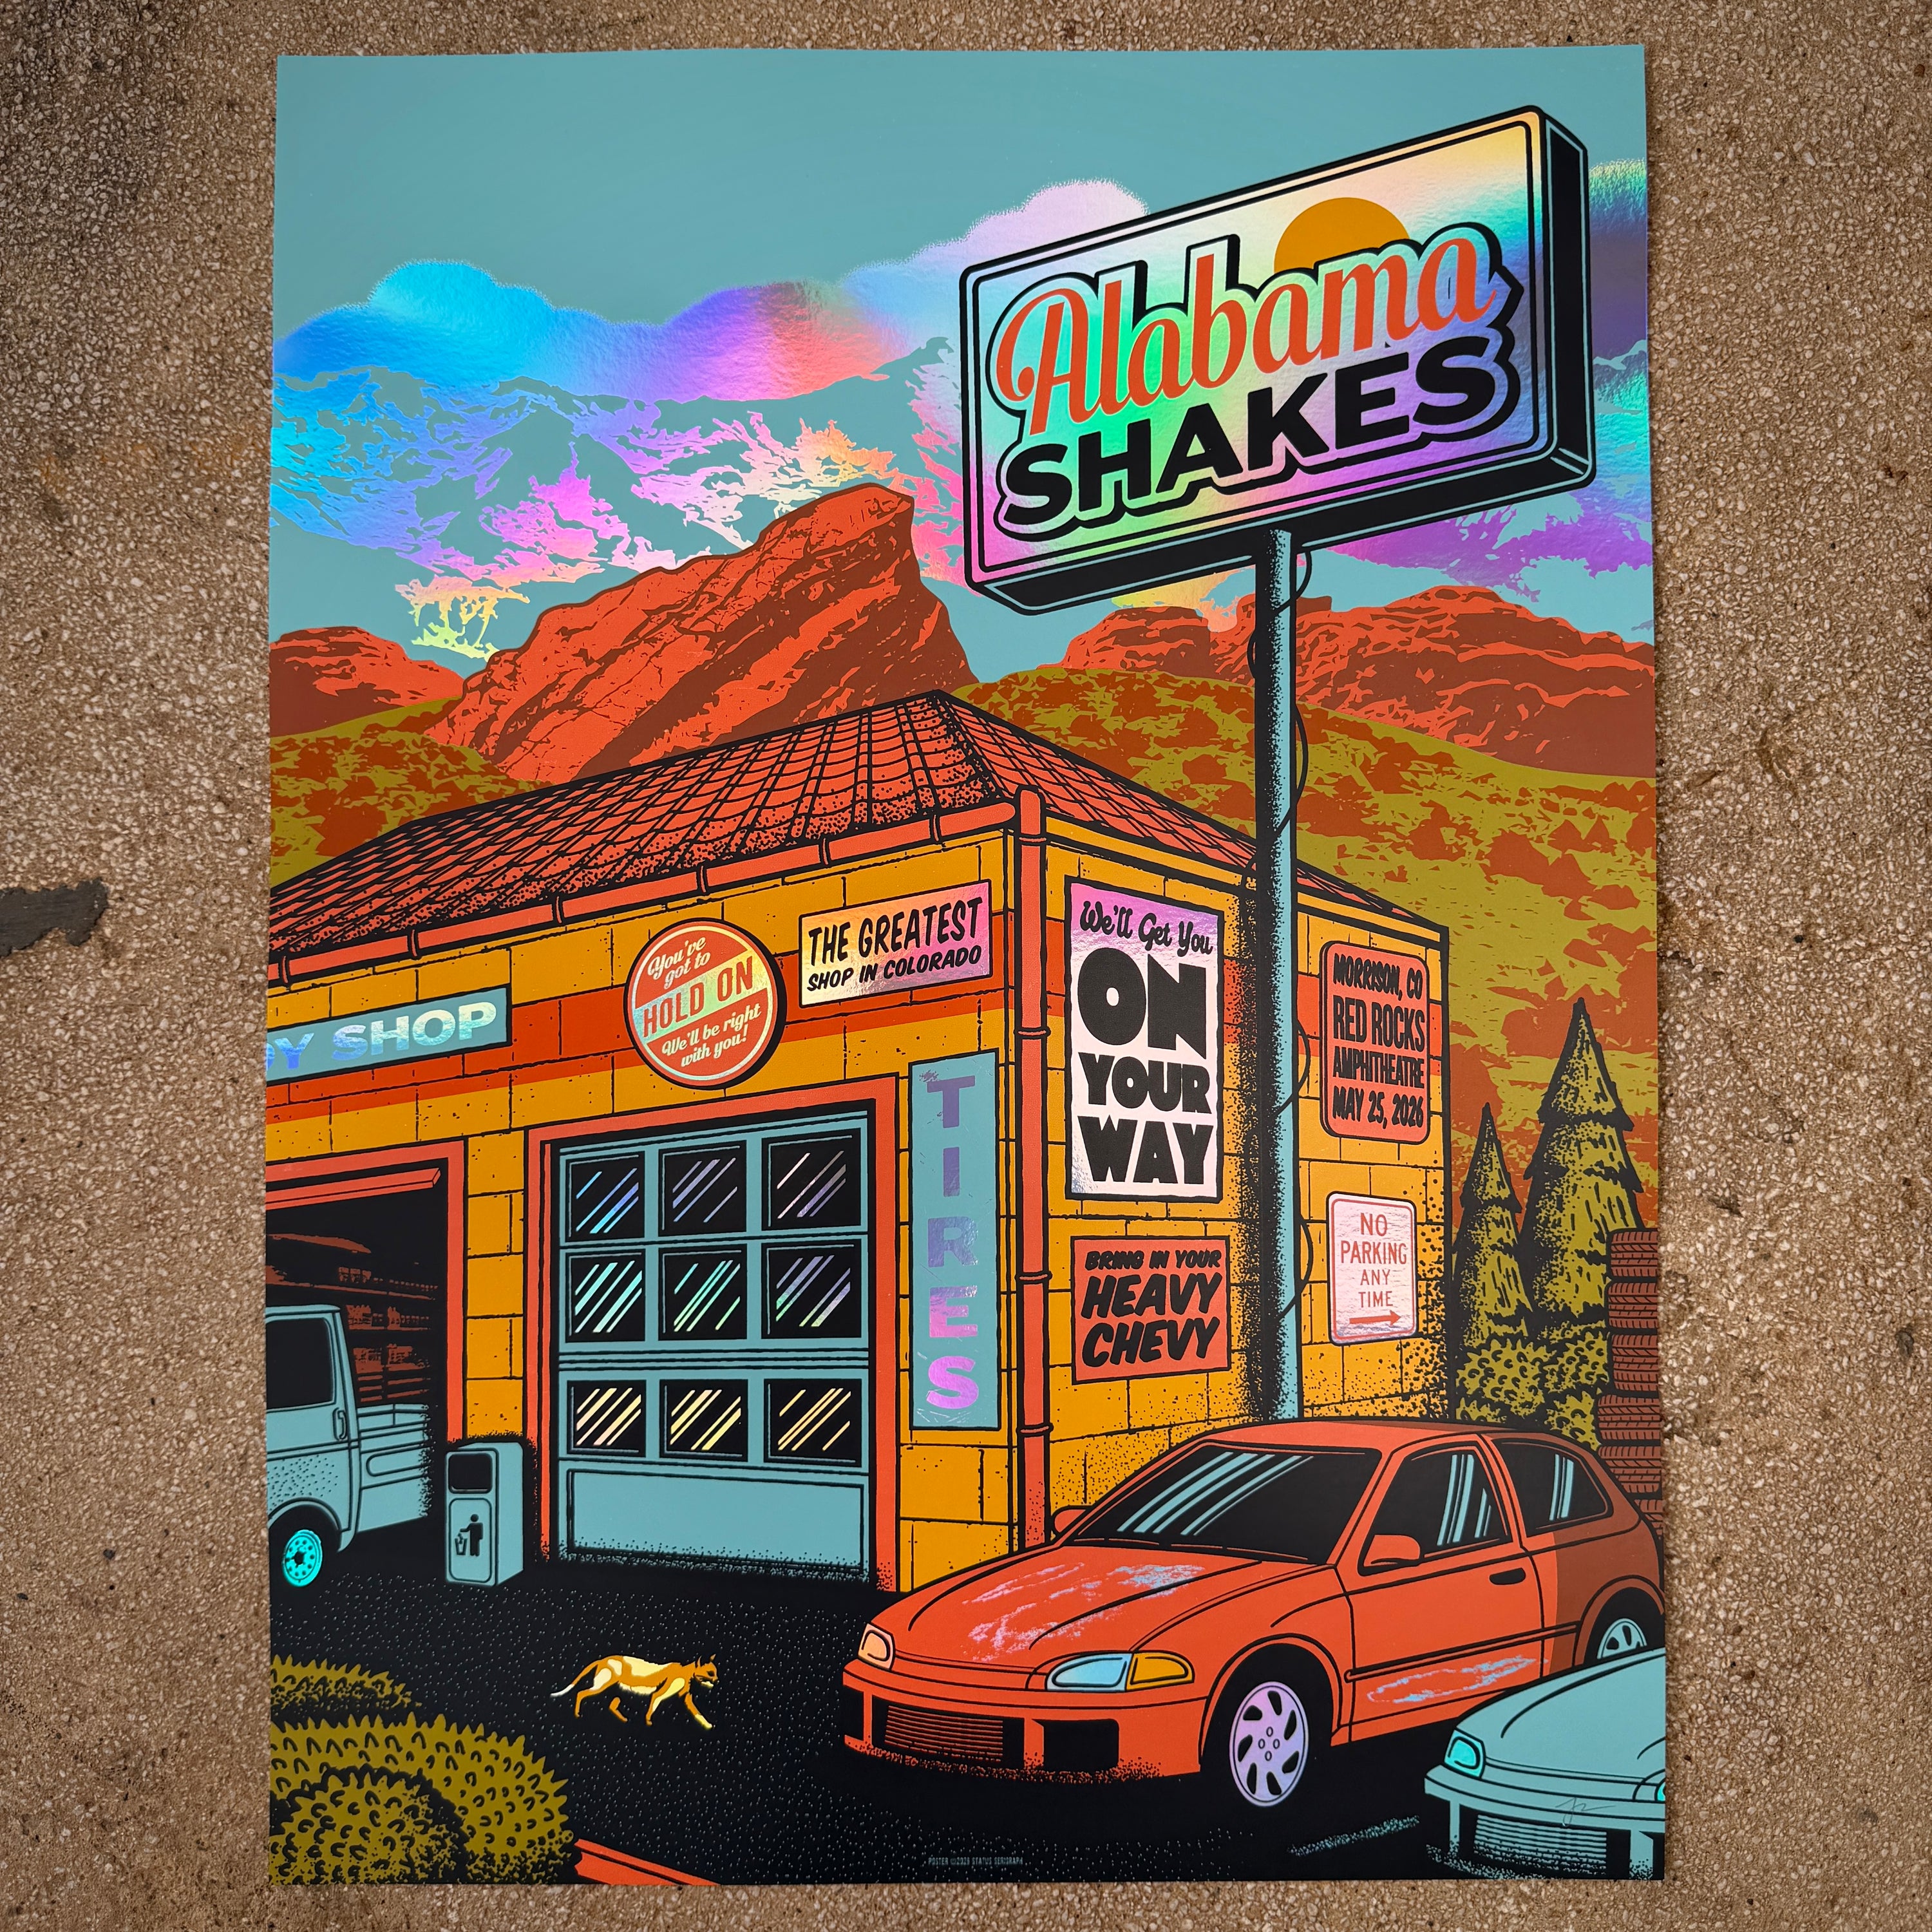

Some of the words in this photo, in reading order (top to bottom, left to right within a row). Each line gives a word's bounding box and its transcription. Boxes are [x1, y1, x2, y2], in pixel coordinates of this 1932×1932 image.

[996, 237, 1497, 435] Alabama
[1005, 336, 1495, 526] SHAKES
[808, 921, 851, 966] THE
[858, 896, 982, 958] GREATEST
[1080, 900, 1133, 940] We'll
[1138, 913, 1172, 951] Get
[1177, 920, 1213, 957] You
[647, 937, 706, 980] You've
[664, 961, 691, 990] got
[694, 952, 710, 969] to
[807, 967, 854, 991] SHOP
[859, 963, 878, 983] IN
[884, 945, 982, 979] COLORADO
[1333, 952, 1403, 1001] MORRISON,
[1406, 967, 1423, 999] CO
[643, 982, 705, 1037] HOLD
[717, 956, 753, 1001] ON
[1077, 947, 1206, 1060] ON
[266, 1032, 315, 1072] Y
[332, 1001, 497, 1061] SHOP
[661, 1028, 700, 1056] We'll
[703, 1024, 720, 1040] be
[723, 1003, 762, 1031] right
[681, 1045, 711, 1068] with
[714, 1024, 748, 1059] you!
[1333, 995, 1367, 1043] RED
[1372, 1001, 1425, 1052] ROCKS
[1078, 1052, 1212, 1114] YOUR
[1333, 1046, 1425, 1088] AMPHITHEATRE
[1332, 1085, 1364, 1122] MAY
[1368, 1090, 1387, 1129] 25,
[1392, 1093, 1424, 1128] 2026
[1077, 1115, 1214, 1185] WAY
[926, 1075, 979, 1409] TIRES
[1360, 1213, 1387, 1236] NO
[1085, 1250, 1144, 1271] BRING
[1149, 1250, 1170, 1269] IN
[1175, 1249, 1222, 1269] YOUR
[1341, 1240, 1406, 1264] PARKING
[1081, 1273, 1222, 1319] HEAVY
[1358, 1291, 1393, 1308] TIME
[1360, 1269, 1390, 1285] ANY
[1082, 1316, 1220, 1367] CHEVY
[972, 1857, 992, 1865] STATUS
